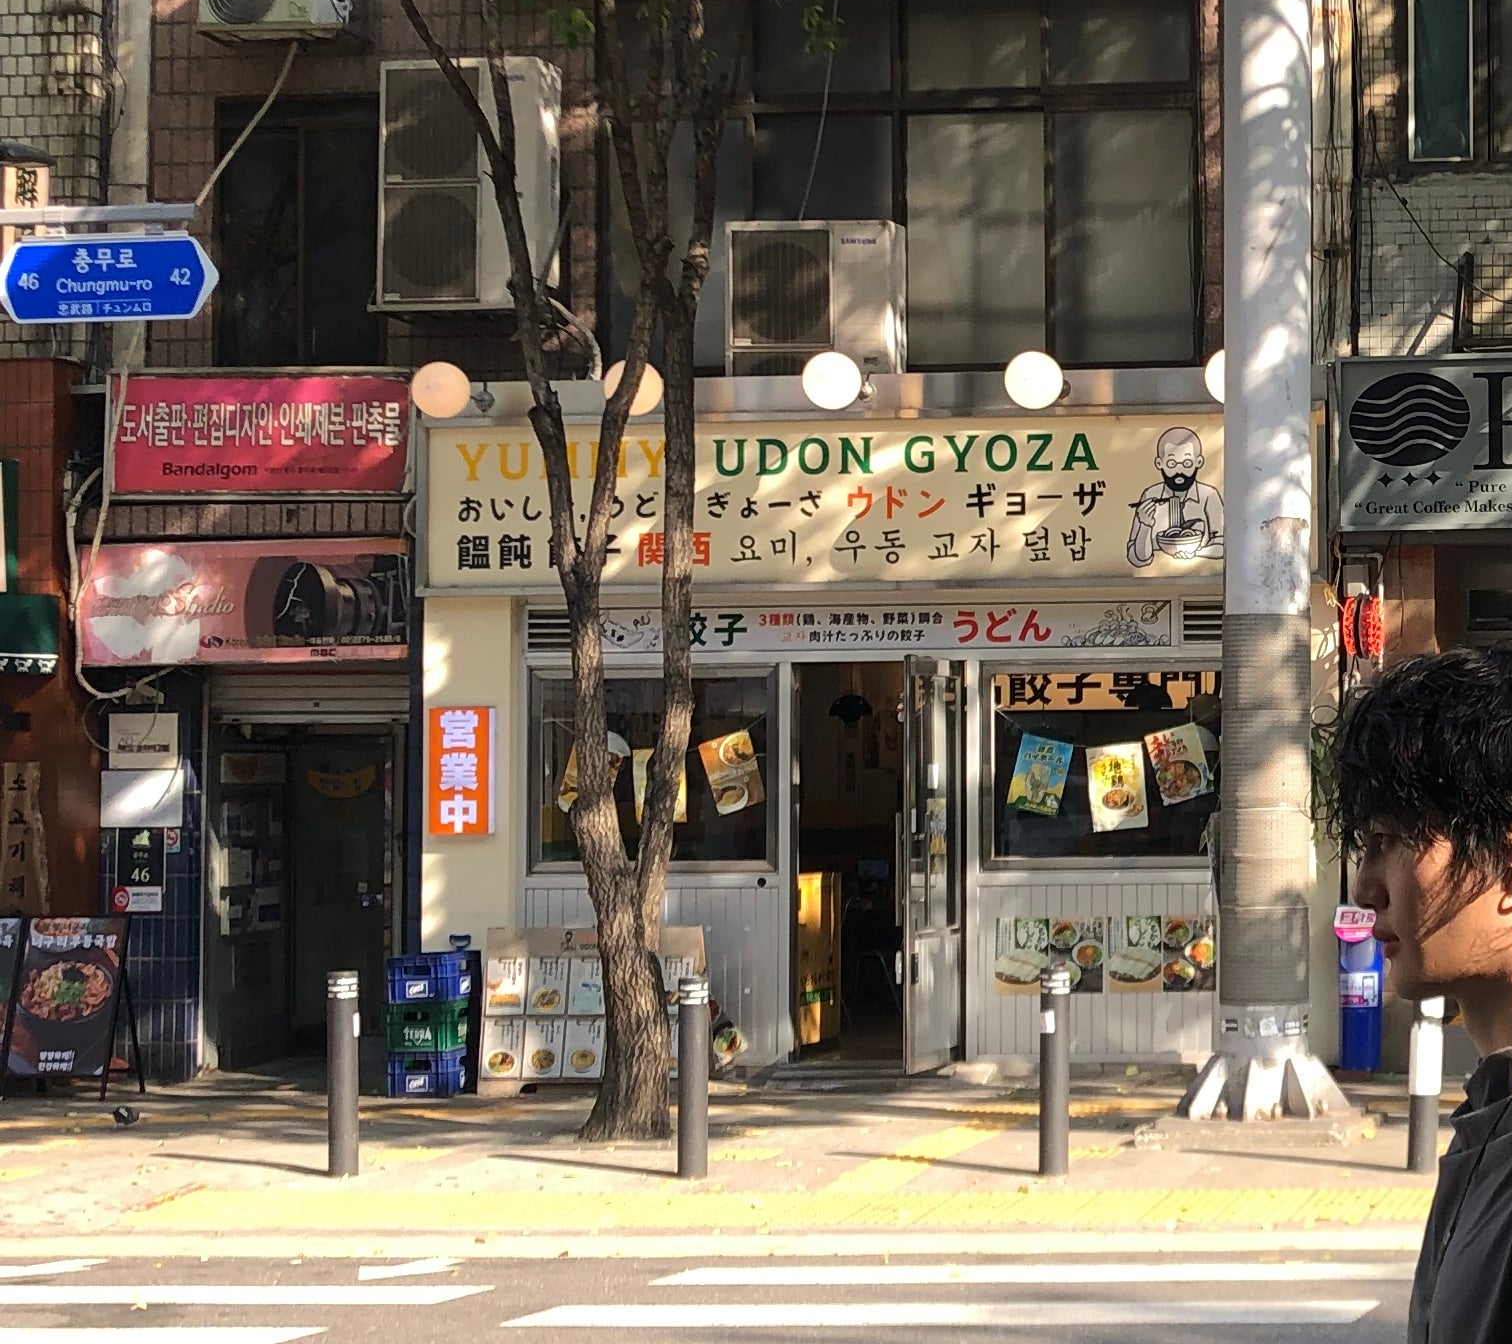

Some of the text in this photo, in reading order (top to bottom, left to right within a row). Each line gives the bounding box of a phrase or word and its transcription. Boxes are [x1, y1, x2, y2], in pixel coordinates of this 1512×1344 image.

[71, 248, 138, 274] 충무로
[18, 273, 40, 291] 46
[169, 268, 191, 286] 42
[56, 278, 153, 299] Chungmu-ro
[713, 437, 875, 477] UDON
[903, 432, 1100, 474] GYOZA
[161, 462, 257, 479] Bandalgom
[1468, 480, 1507, 493] Pure
[706, 490, 823, 520] ぎょーざ
[846, 485, 946, 520] ウドン
[965, 480, 1107, 519] ギョーザ
[1366, 502, 1408, 515] Great
[1412, 500, 1461, 514] Coffee
[1464, 500, 1512, 513] Makes
[834, 530, 907, 564] 우동
[926, 528, 1001, 563] 교자
[1023, 526, 1093, 562] 덮밥
[952, 608, 1053, 645] うどん
[439, 710, 479, 833] 営業中
[130, 867, 151, 883] 46
